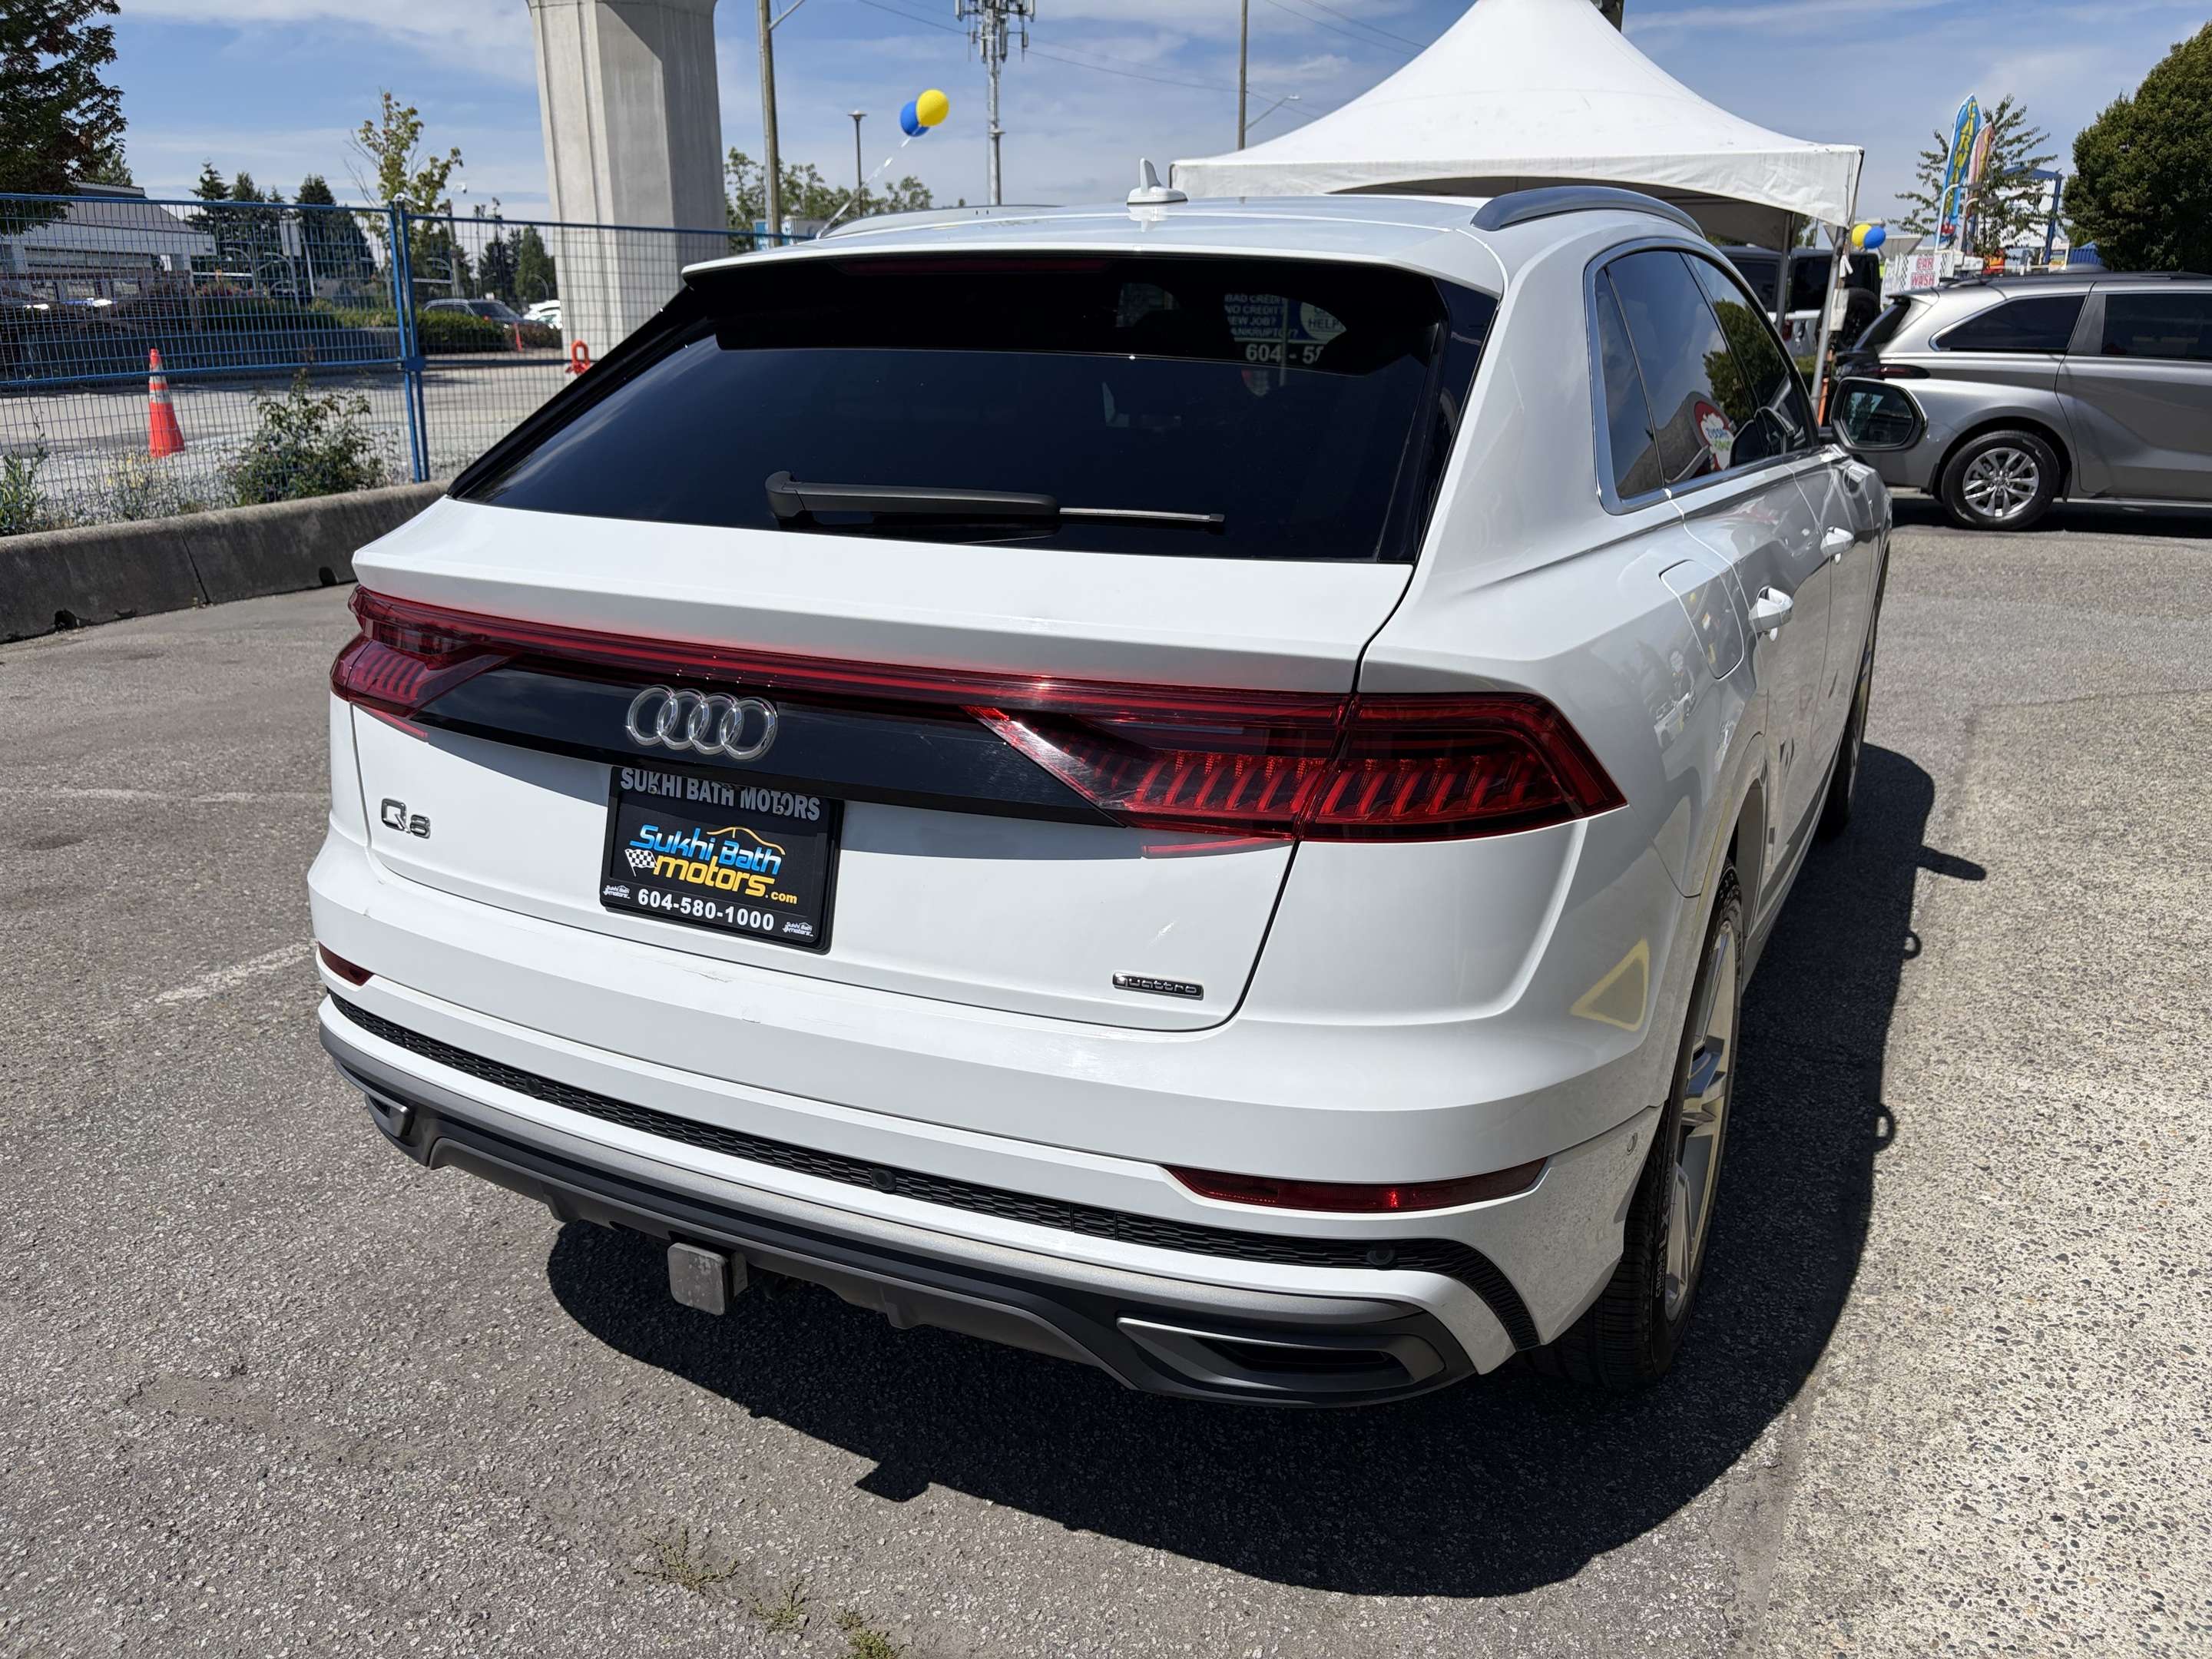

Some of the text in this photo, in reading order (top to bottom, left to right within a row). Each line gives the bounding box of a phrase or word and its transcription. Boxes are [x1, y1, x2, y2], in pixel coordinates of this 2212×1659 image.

[1911, 273, 1936, 286] WASH
[1916, 257, 1934, 270] CAR
[621, 768, 821, 821] SUKHI BATH MOTORS
[381, 798, 431, 839] Q8
[629, 823, 784, 876] Sukhi Bath
[637, 888, 775, 932] 604-580-1000
[1117, 973, 1197, 994] quattro
